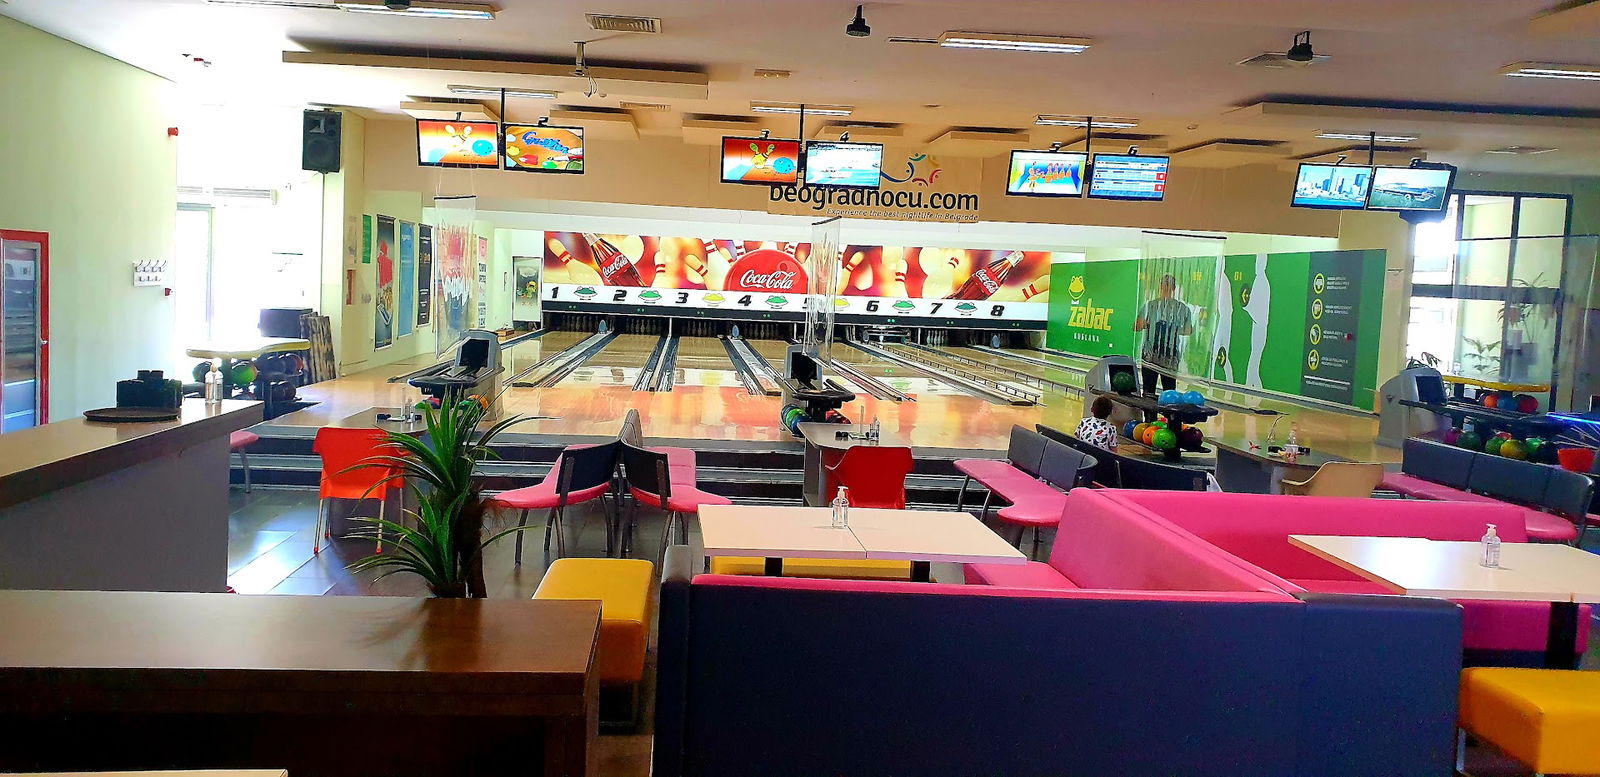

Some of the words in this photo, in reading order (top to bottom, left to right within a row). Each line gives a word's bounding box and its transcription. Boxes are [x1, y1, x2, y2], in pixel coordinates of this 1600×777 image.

[455, 111, 462, 121] 1
[537, 116, 549, 126] 2
[758, 128, 770, 140] 3
[839, 130, 850, 142] 4
[1127, 144, 1139, 155] 6
[1336, 154, 1348, 165] 7
[769, 184, 979, 211] beogradnocu.com
[826, 207, 868, 218] Experience
[869, 209, 882, 217] the
[883, 210, 900, 218] best
[902, 211, 933, 220] nightlife
[944, 212, 979, 222] Belgrade
[551, 286, 560, 299] 1
[612, 289, 628, 302] 2
[675, 292, 689, 304] 3
[737, 294, 752, 307] 4
[866, 300, 880, 312] 6
[930, 302, 943, 315] 7
[990, 304, 1005, 317] 8
